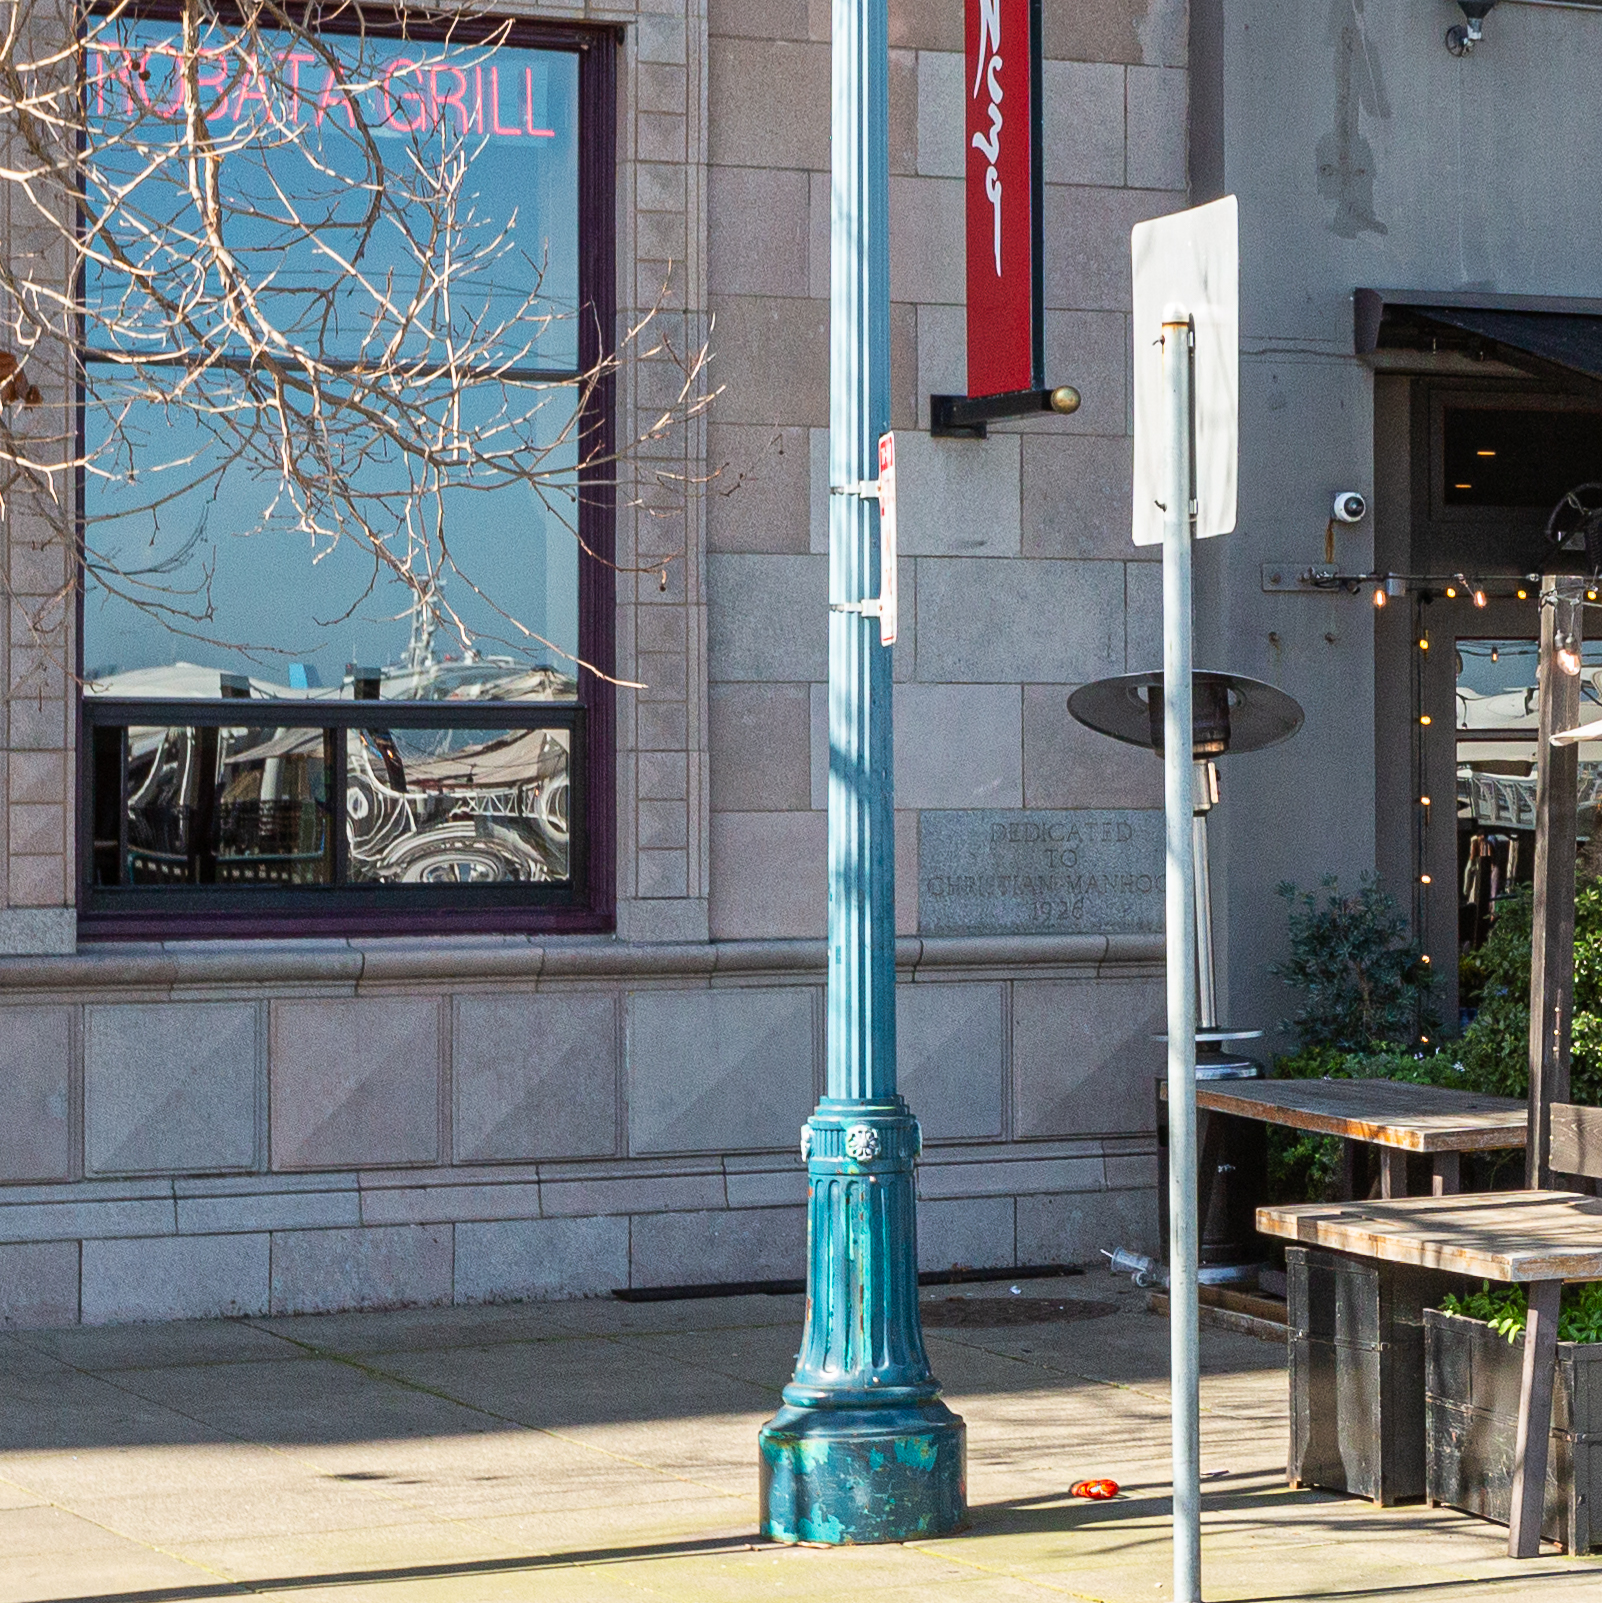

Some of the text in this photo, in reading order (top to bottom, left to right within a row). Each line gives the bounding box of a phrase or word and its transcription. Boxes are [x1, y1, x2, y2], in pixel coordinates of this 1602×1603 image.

[383, 58, 556, 138] GRILL
[989, 821, 1134, 844] DEDICATED
[1044, 848, 1079, 869] TO
[1030, 900, 1085, 922] 1926
